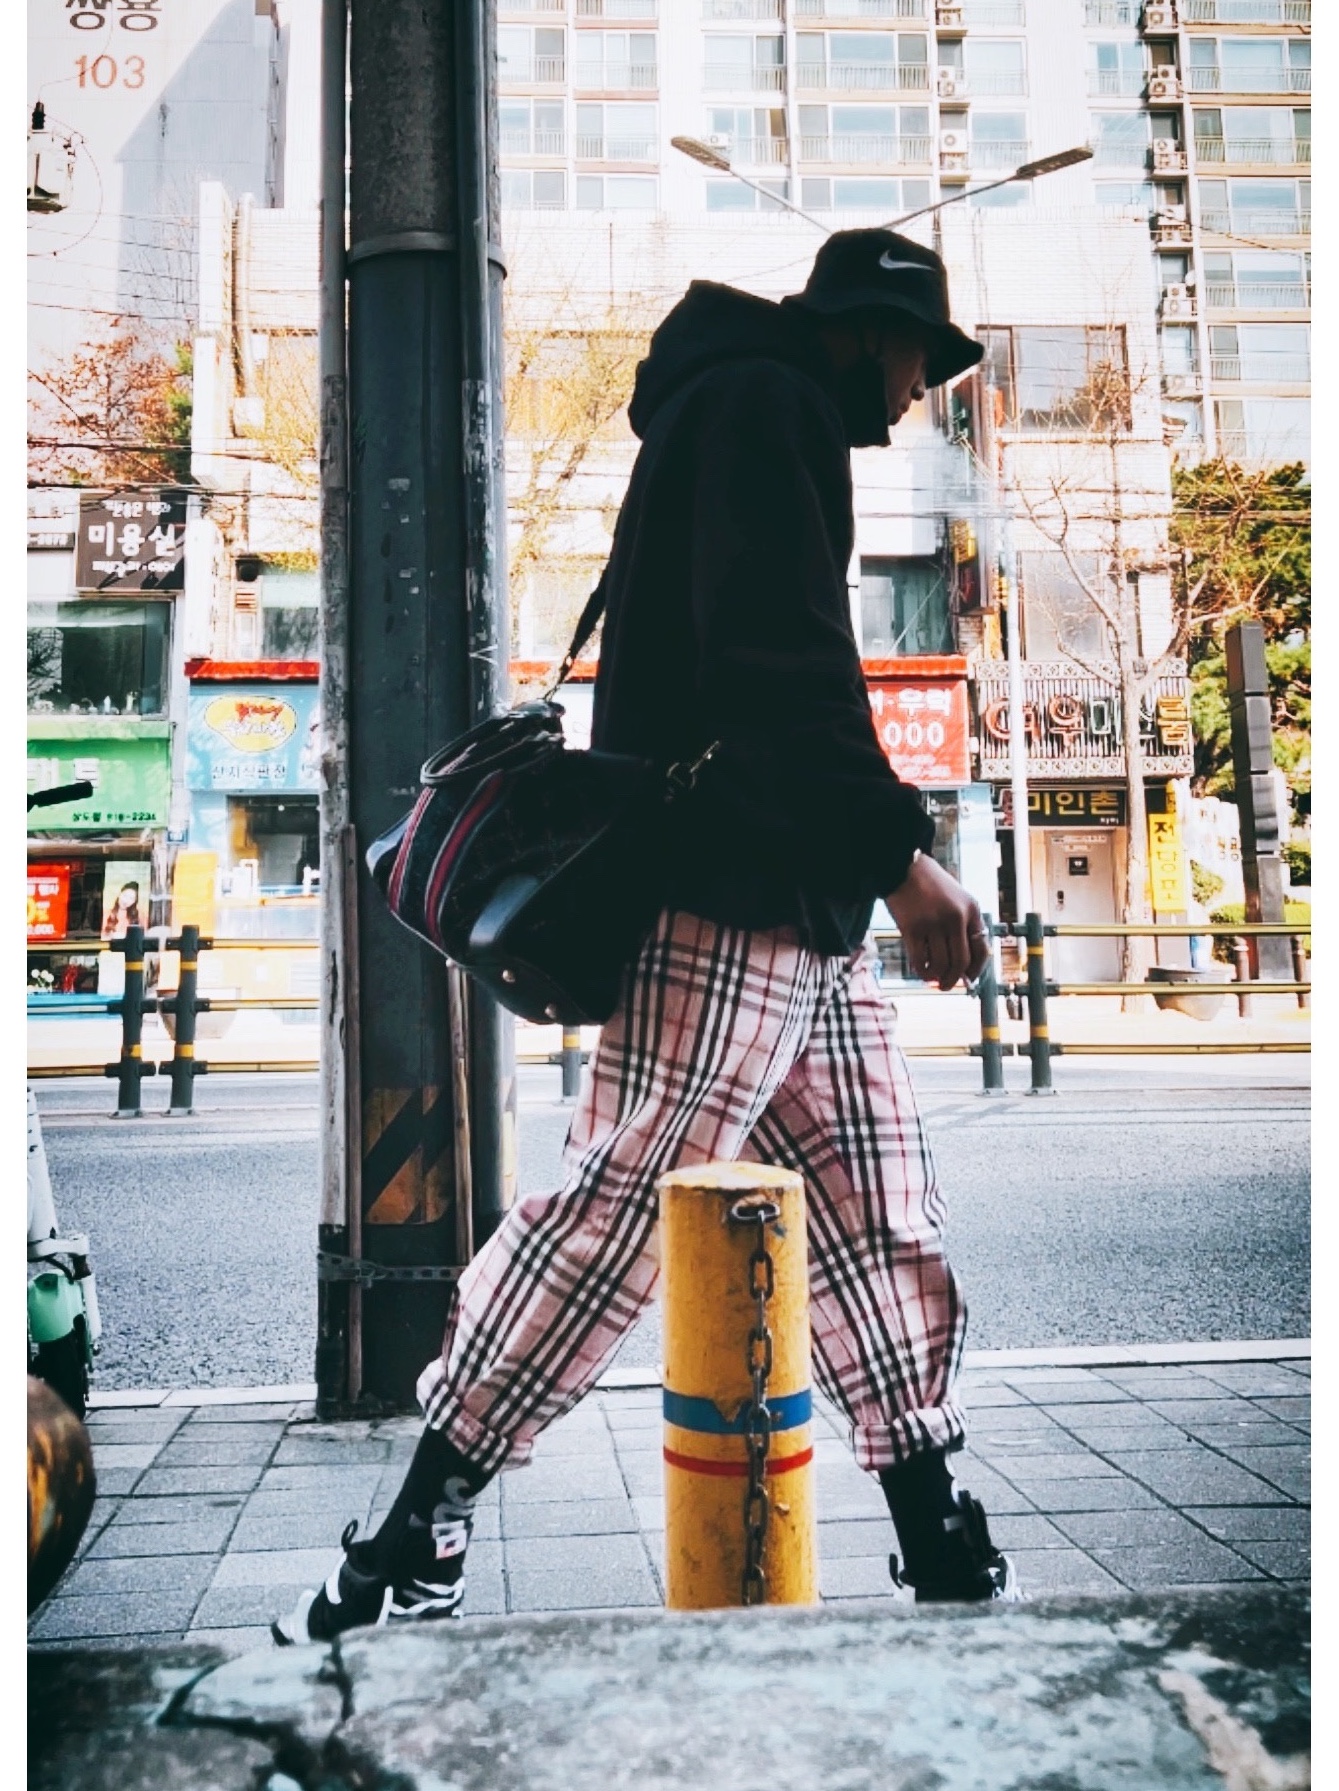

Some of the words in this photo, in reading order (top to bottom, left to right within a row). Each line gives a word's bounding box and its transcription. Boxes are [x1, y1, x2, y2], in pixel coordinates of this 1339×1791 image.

[75, 54, 146, 89] 103
[88, 521, 176, 557] 미용실
[1028, 787, 1118, 815] 미인촌
